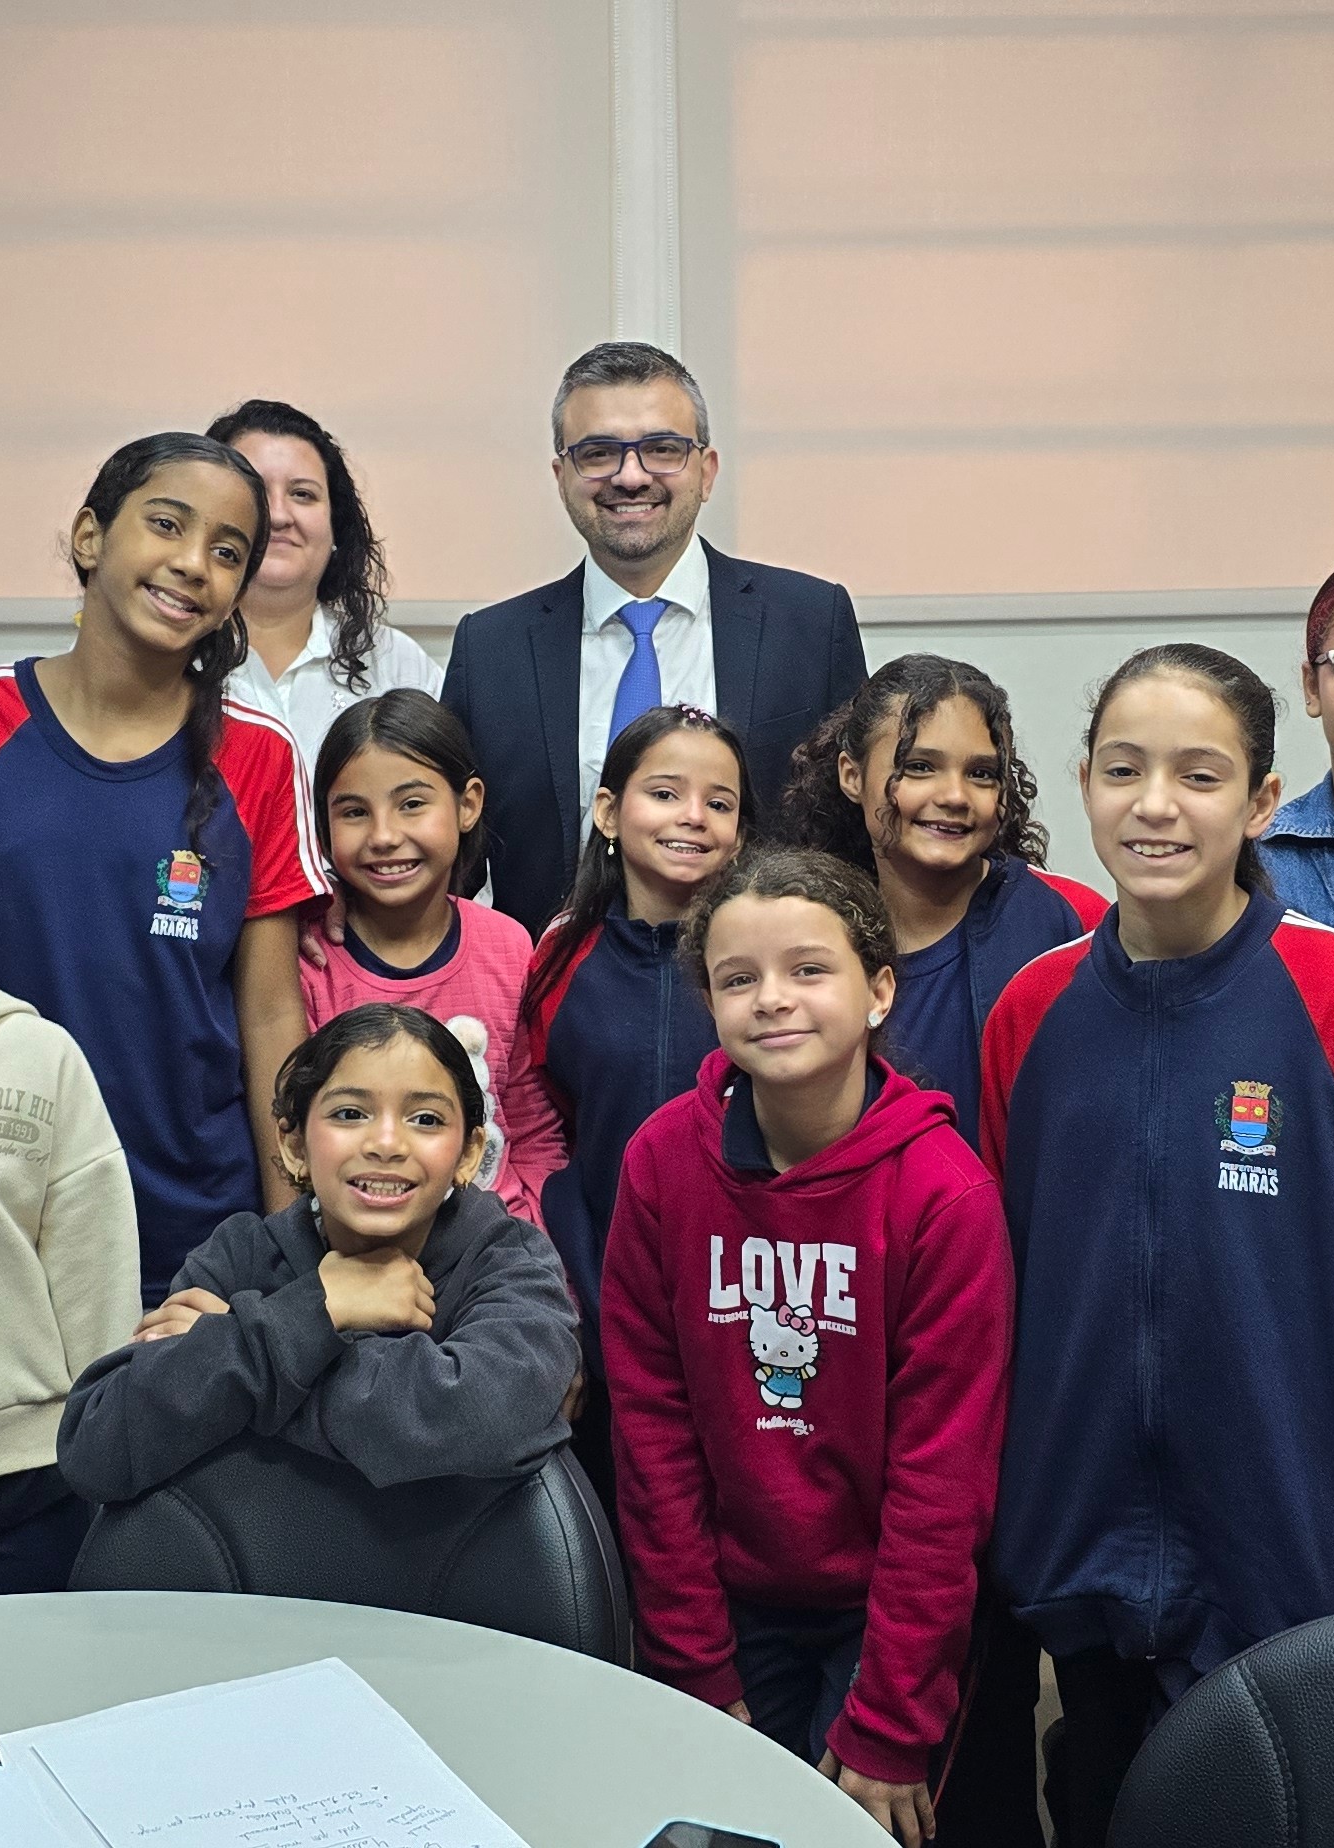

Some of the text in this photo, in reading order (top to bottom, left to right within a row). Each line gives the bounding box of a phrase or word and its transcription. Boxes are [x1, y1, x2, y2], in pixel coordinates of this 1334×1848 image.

[149, 917, 199, 941] ARARAS
[28, 1094, 54, 1126] HIL
[1218, 1169, 1279, 1196] ARARAS
[709, 1235, 857, 1322] LOVE
